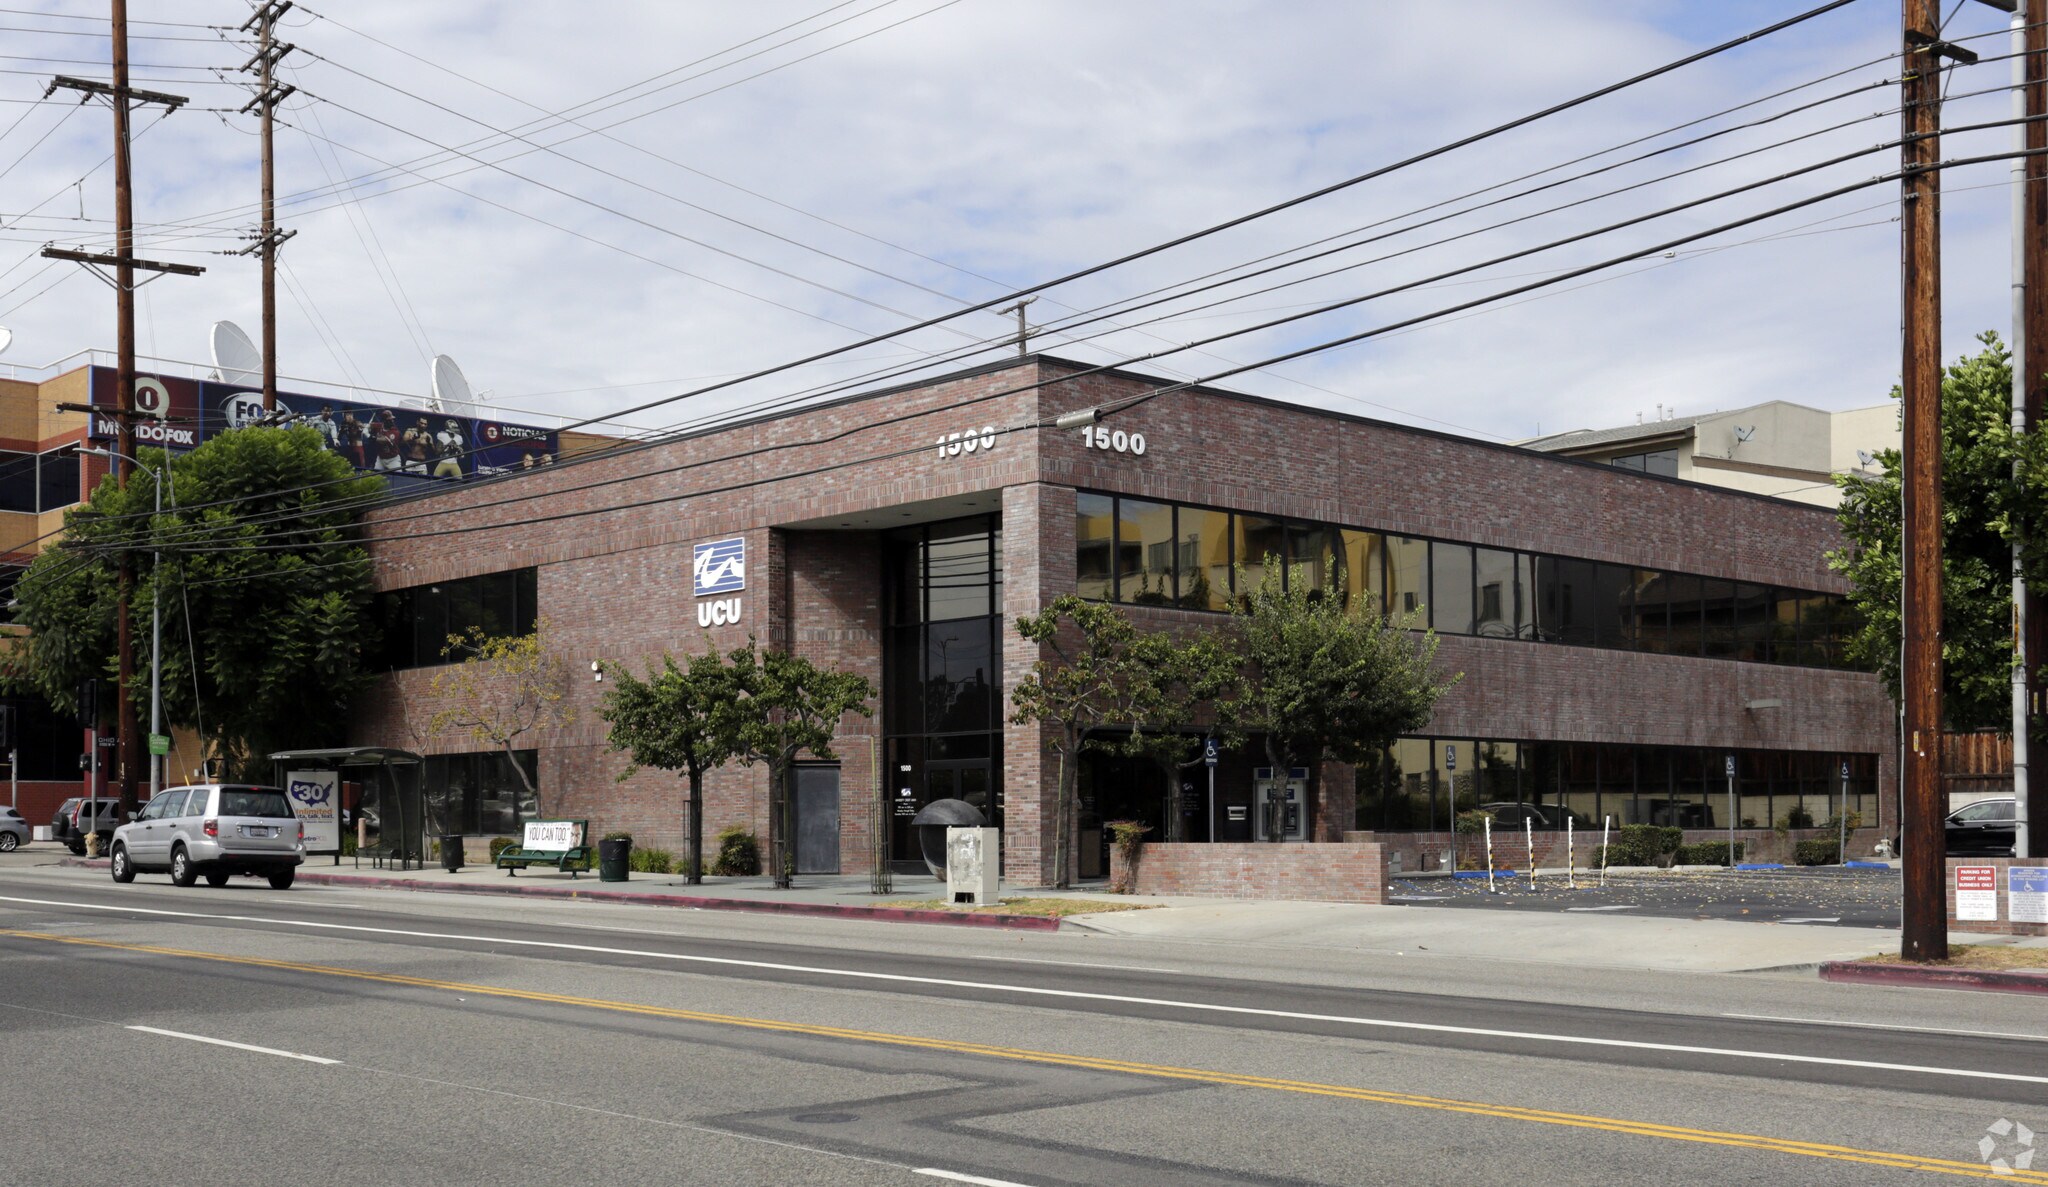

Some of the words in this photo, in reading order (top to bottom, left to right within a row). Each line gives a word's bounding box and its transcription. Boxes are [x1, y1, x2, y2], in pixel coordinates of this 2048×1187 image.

[99, 420, 194, 445] MDOFOX
[935, 426, 996, 459] 1500
[1082, 426, 1146, 456] 1500
[698, 598, 741, 627] UCU
[293, 784, 323, 801] $30
[529, 827, 540, 841] YOU
[541, 827, 554, 841] CAN
